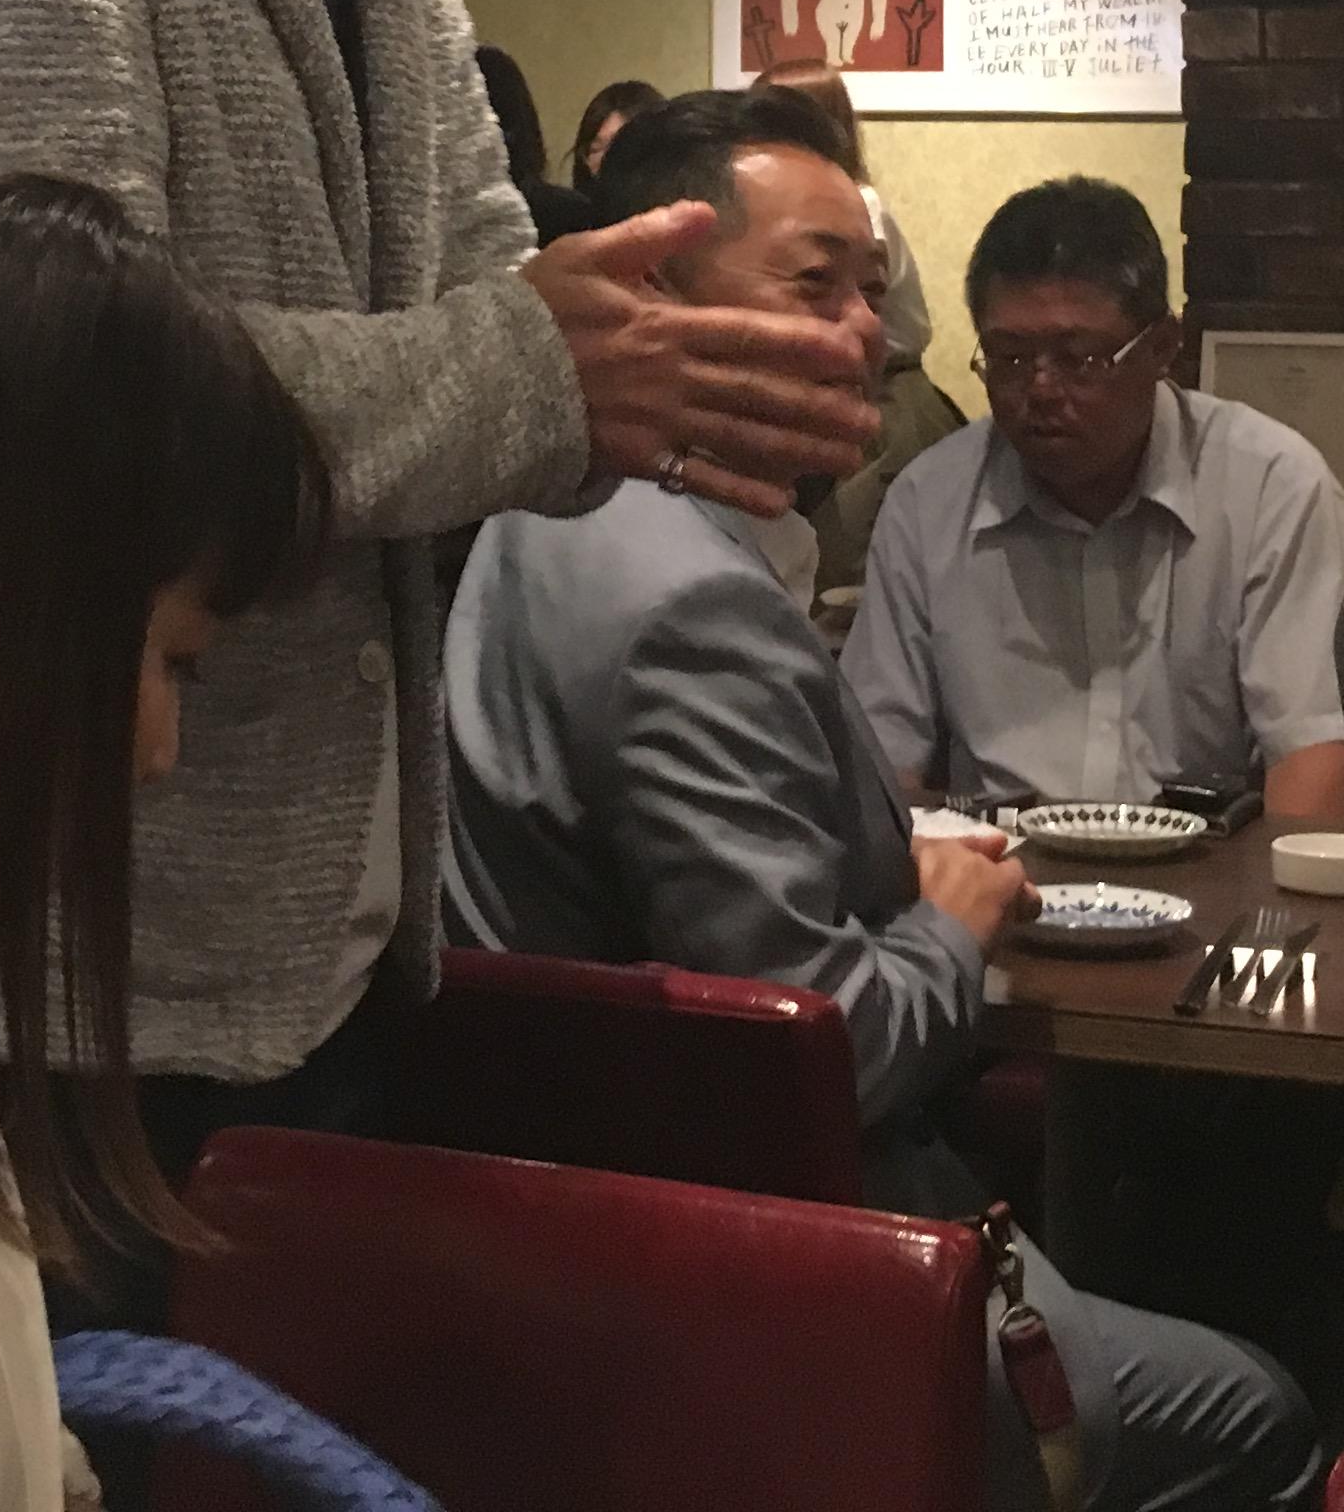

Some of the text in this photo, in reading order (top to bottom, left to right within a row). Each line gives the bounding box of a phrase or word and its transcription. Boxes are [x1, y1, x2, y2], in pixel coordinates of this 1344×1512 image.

[1037, 17, 1077, 37] HEAR
[1083, 13, 1137, 35] FROM
[994, 41, 1049, 60] EVERY
[1060, 38, 1089, 56] DAY
